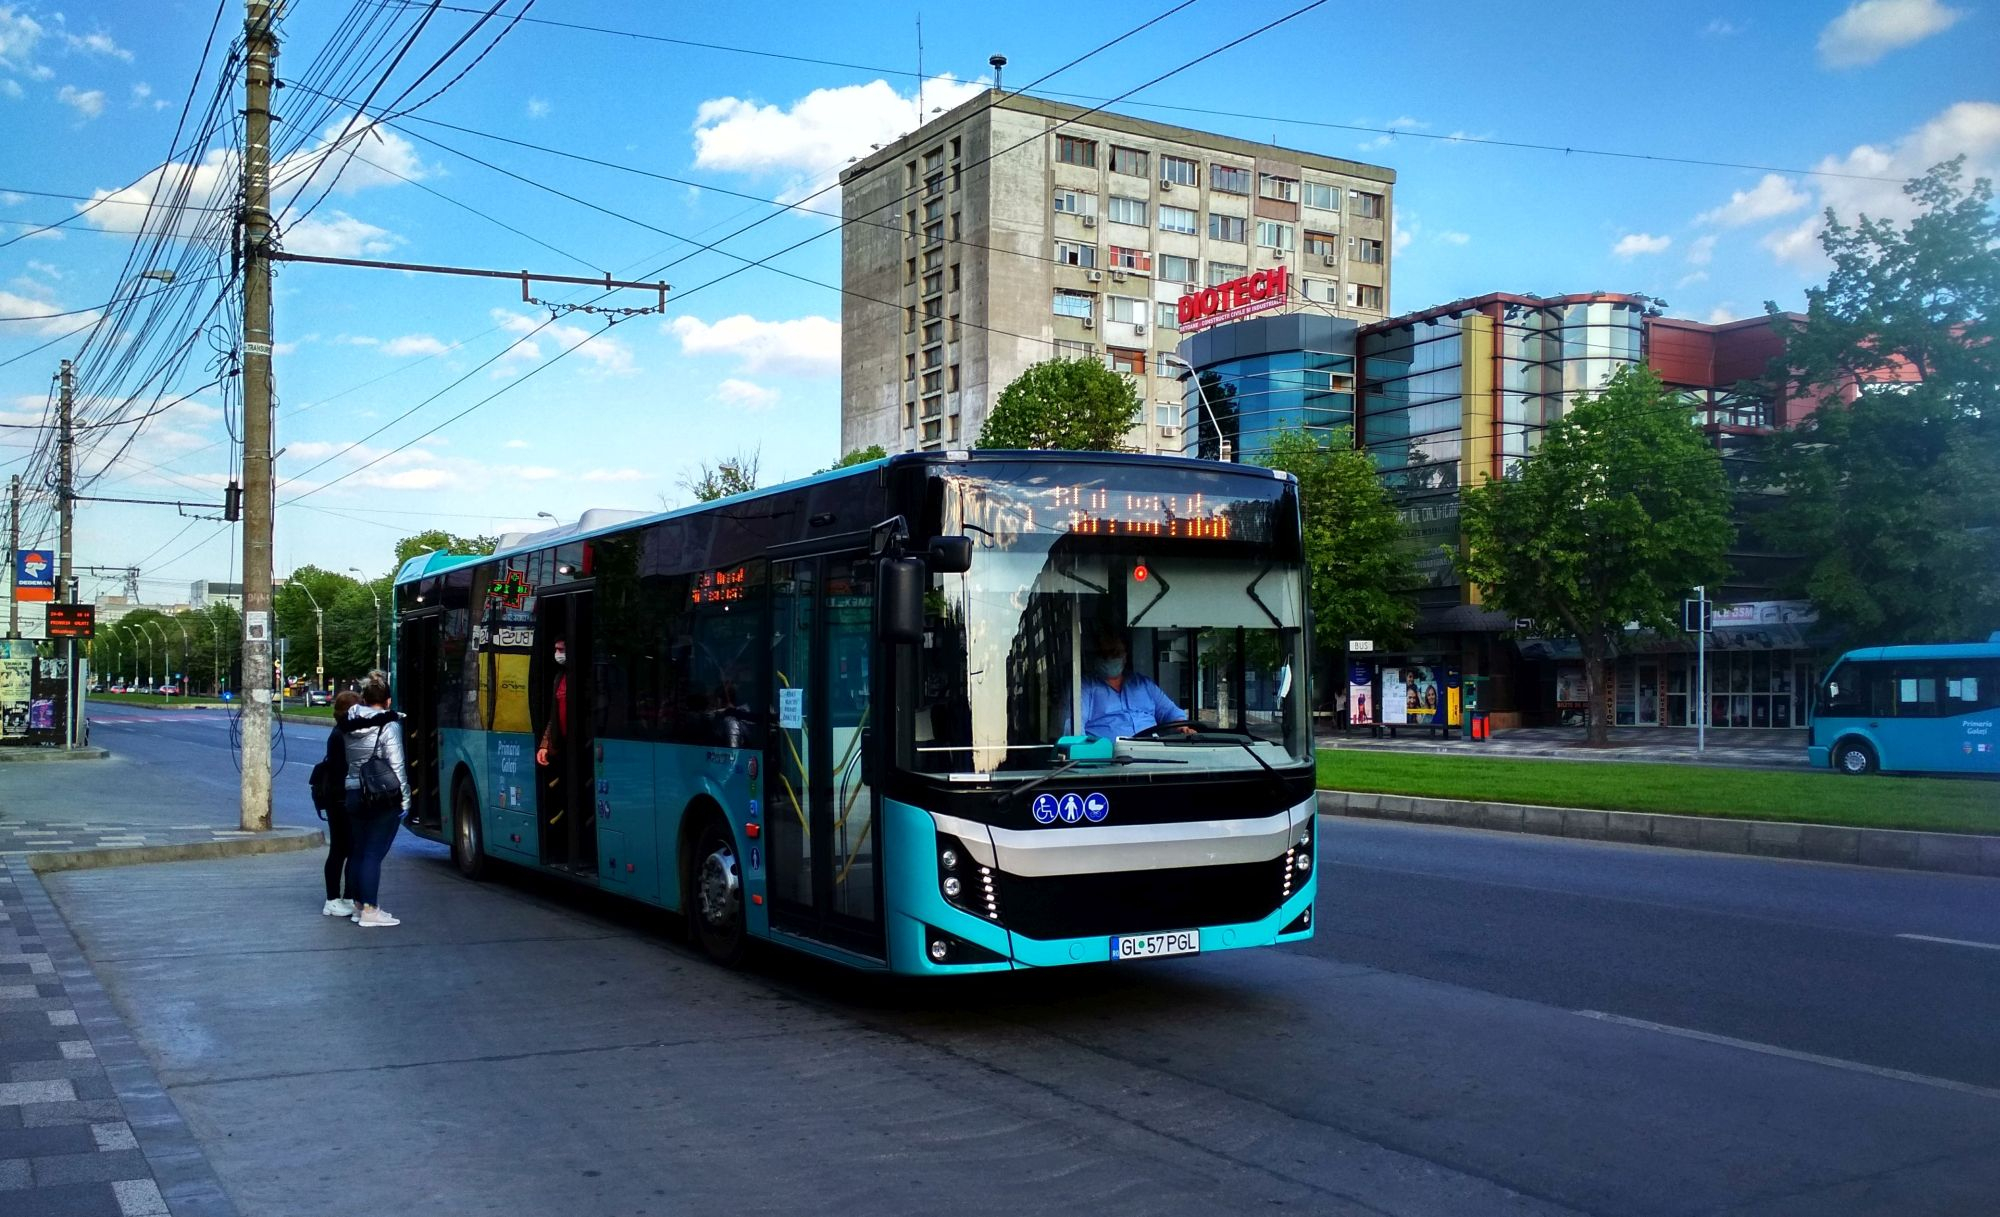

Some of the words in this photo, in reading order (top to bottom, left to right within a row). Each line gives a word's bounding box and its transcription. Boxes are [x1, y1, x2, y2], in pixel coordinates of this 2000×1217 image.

[1178, 265, 1287, 324] BIOTECH
[1231, 309, 1245, 318] CIVILE
[1252, 298, 1283, 312] INDUSTRIALE
[1354, 641, 1368, 650] BUS
